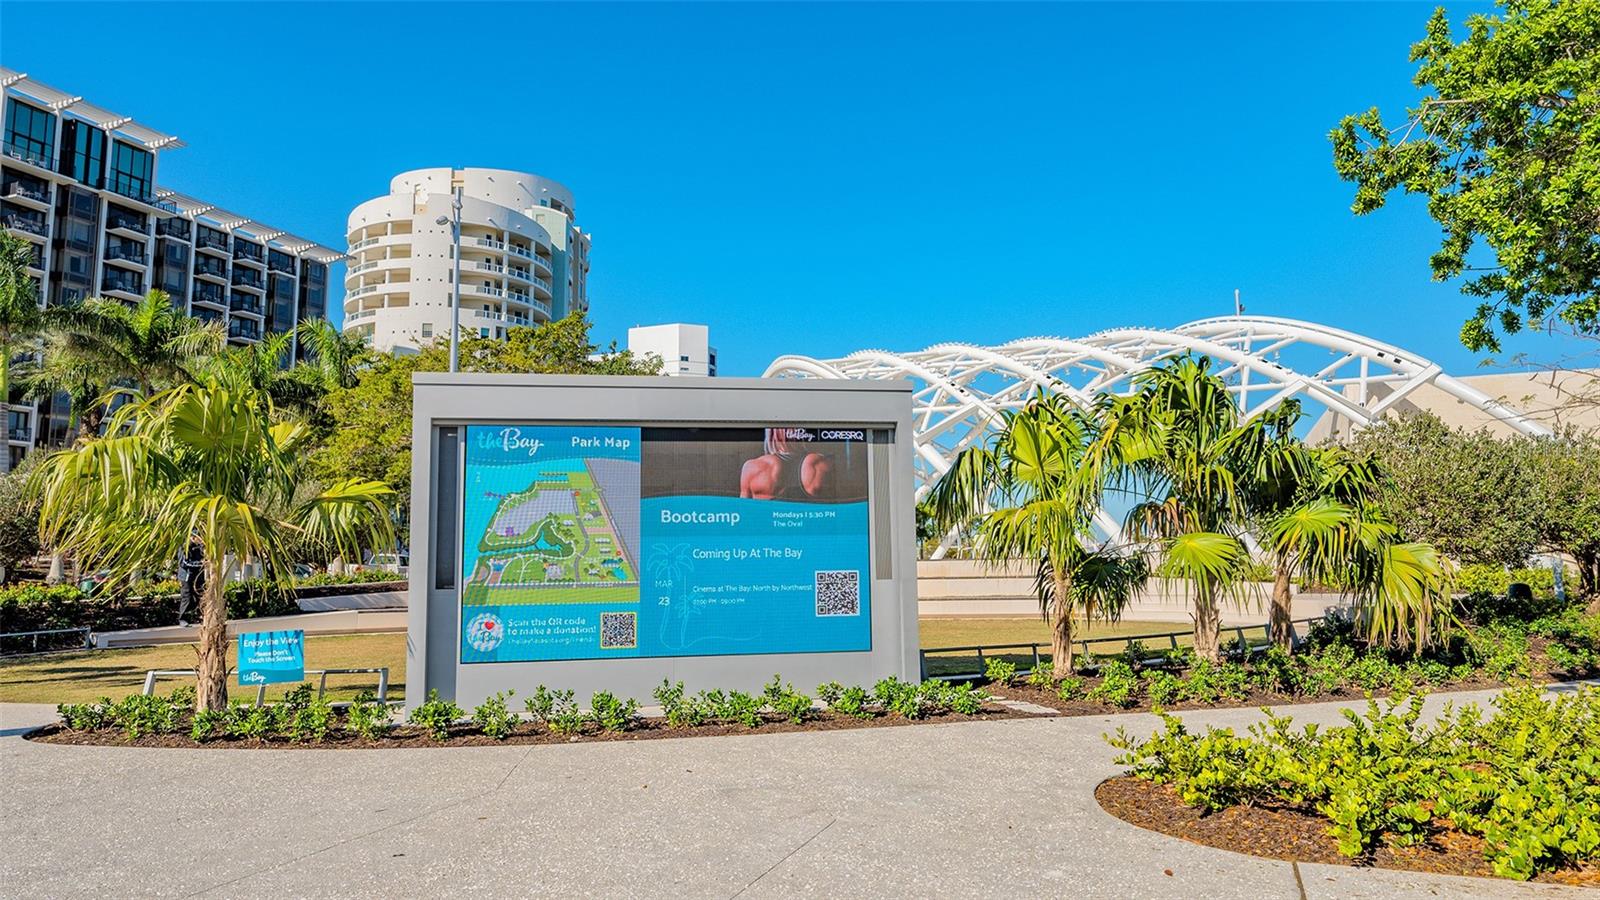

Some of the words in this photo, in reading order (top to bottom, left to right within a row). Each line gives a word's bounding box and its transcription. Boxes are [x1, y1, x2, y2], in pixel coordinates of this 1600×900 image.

[820, 430, 864, 441] CORESRQ
[571, 436, 601, 448] Park
[604, 436, 631, 450] Map
[660, 509, 740, 527] Bootcamp
[772, 511, 804, 519] Mondays
[692, 548, 730, 561] Coming
[733, 548, 748, 560] Up
[749, 548, 761, 558] At
[762, 547, 782, 558] The
[784, 547, 803, 560] Bay
[655, 580, 673, 588] MAR
[692, 585, 717, 593] Cinema
[725, 584, 738, 592] The
[752, 584, 771, 592] North
[772, 584, 780, 592] by
[780, 584, 813, 592] Northwest
[658, 596, 671, 606] 23
[508, 618, 529, 627] Scan
[531, 618, 547, 626] the
[548, 617, 562, 626] QR
[563, 617, 586, 625] code
[507, 627, 518, 636] to
[519, 627, 545, 635] make
[553, 625, 597, 634] donation!
[243, 639, 265, 648] Enjoy
[265, 638, 279, 646] the
[280, 636, 298, 645] View
